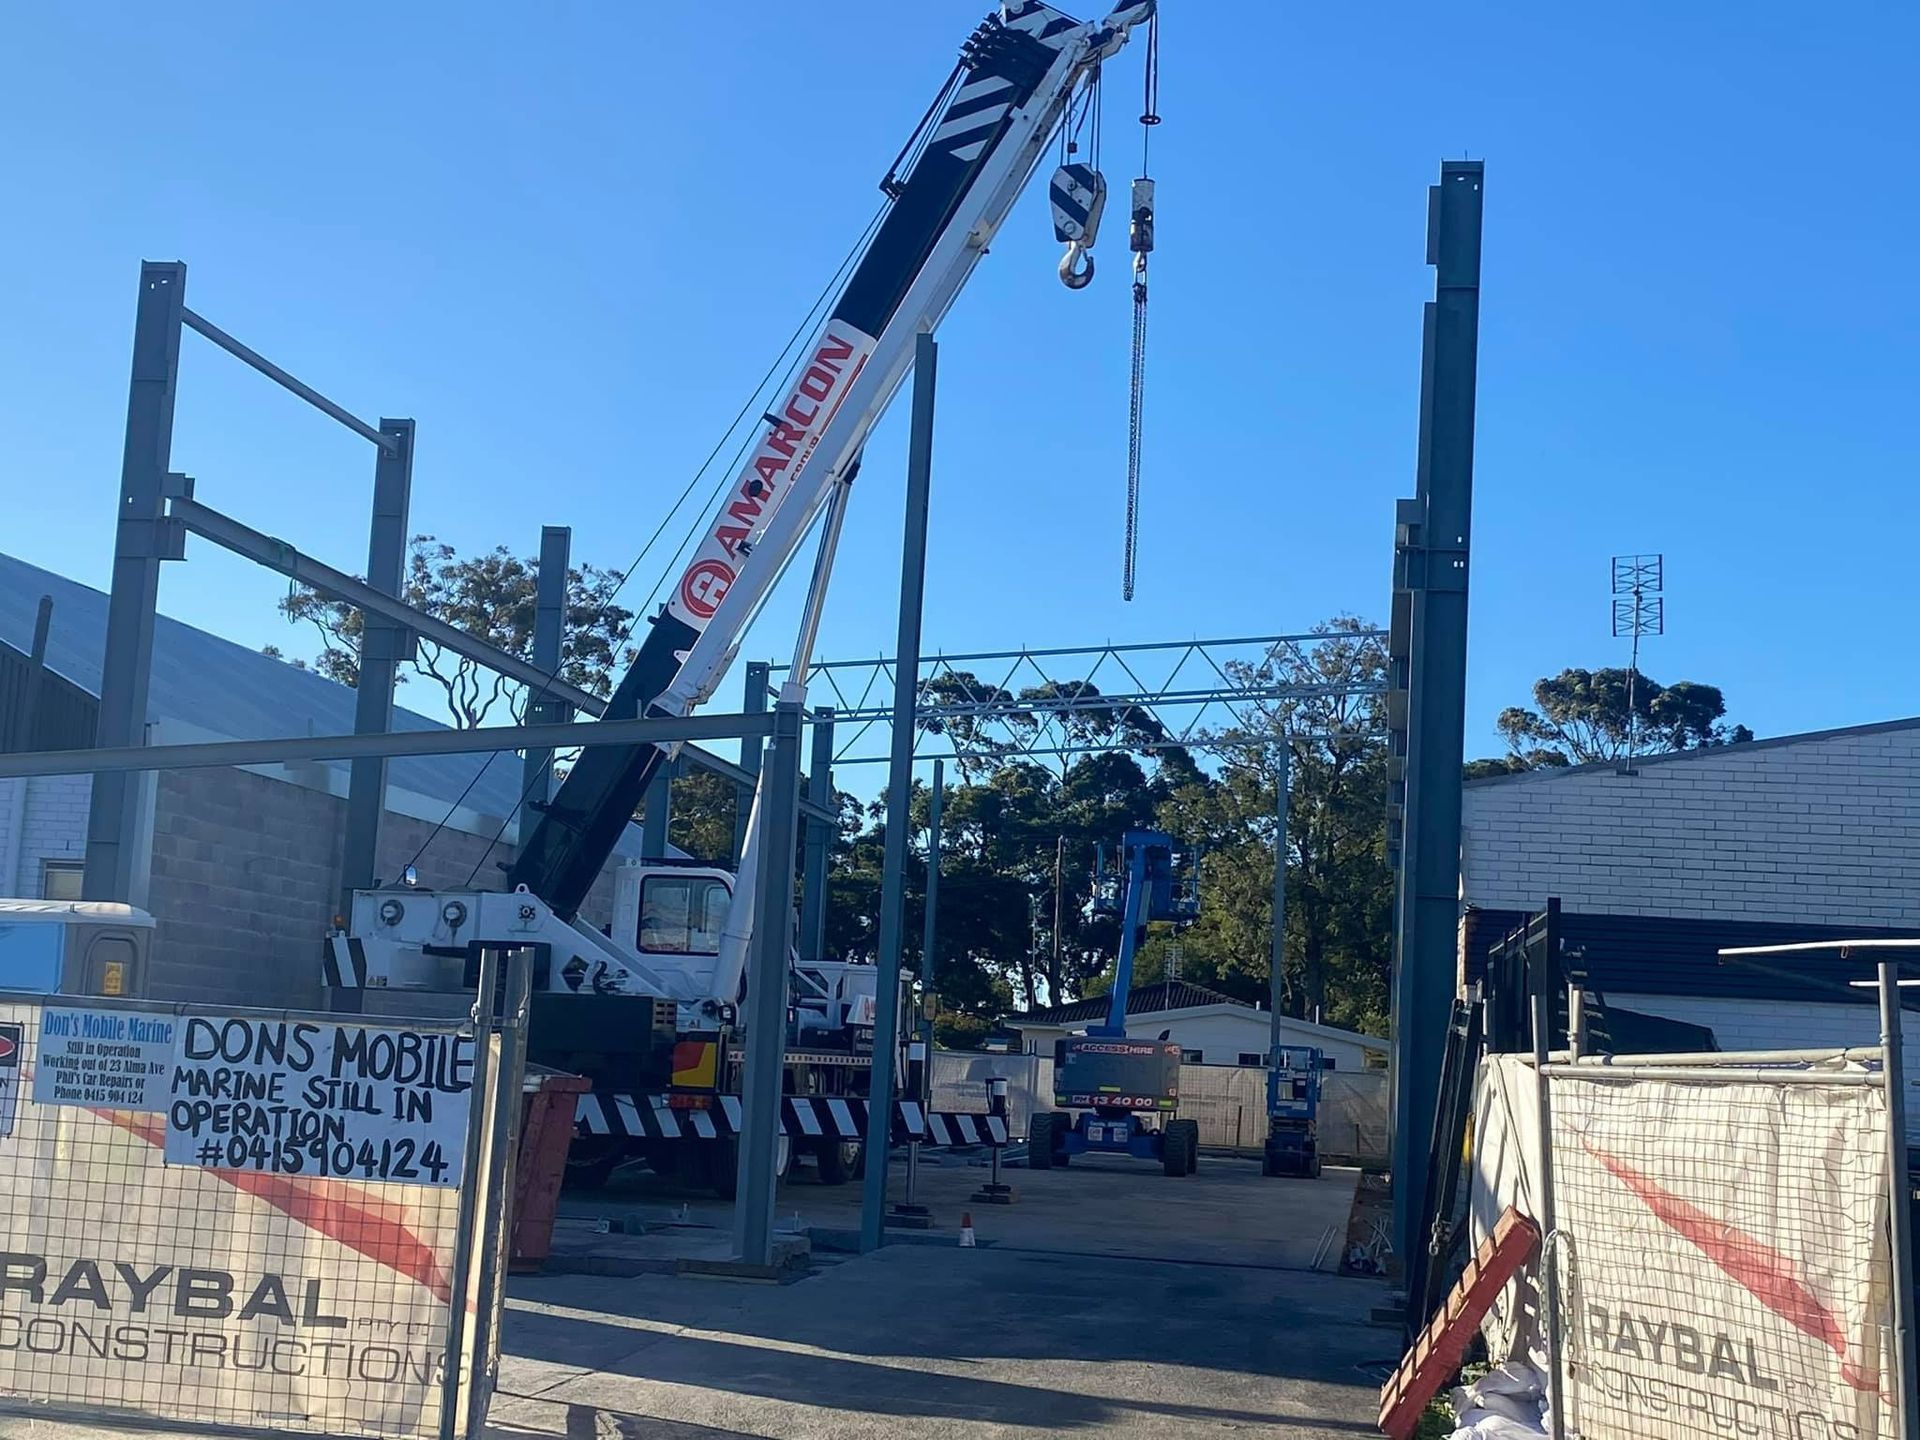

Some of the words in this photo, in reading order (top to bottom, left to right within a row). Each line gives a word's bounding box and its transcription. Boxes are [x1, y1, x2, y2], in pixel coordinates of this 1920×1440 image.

[715, 333, 855, 561] AMARCON
[44, 1011, 79, 1037] Don's
[82, 1014, 125, 1041] Mobile
[128, 1017, 172, 1044] Marine
[66, 1041, 83, 1054] Still
[86, 1041, 95, 1054] in
[97, 1043, 141, 1058] Operation
[185, 1018, 320, 1072] DONS
[331, 1027, 476, 1093] MOBILE
[1129, 1046, 1154, 1055] HIRE
[43, 1054, 79, 1070] Working
[81, 1057, 97, 1069] out
[99, 1056, 107, 1070] of
[109, 1060, 121, 1071] 23
[123, 1060, 146, 1074] Alma
[148, 1062, 165, 1075] Ave
[56, 1070, 81, 1085] Phil's
[82, 1072, 98, 1086] Car
[99, 1073, 133, 1089] Repairs
[135, 1078, 145, 1089] or
[54, 1086, 82, 1100] Phone
[84, 1087, 105, 1101] 0415
[108, 1089, 125, 1103] 904
[127, 1090, 144, 1104] 124
[171, 1065, 286, 1104] MARINE
[302, 1075, 383, 1115] STILL
[393, 1087, 433, 1123] IN
[1093, 1096, 1109, 1105] 13
[1111, 1096, 1131, 1106] 40
[1134, 1097, 1153, 1107] 00
[0, 1251, 348, 1329] RAYBAL
[358, 1317, 400, 1334] PTY
[1588, 1302, 1778, 1391] RAYBAL
